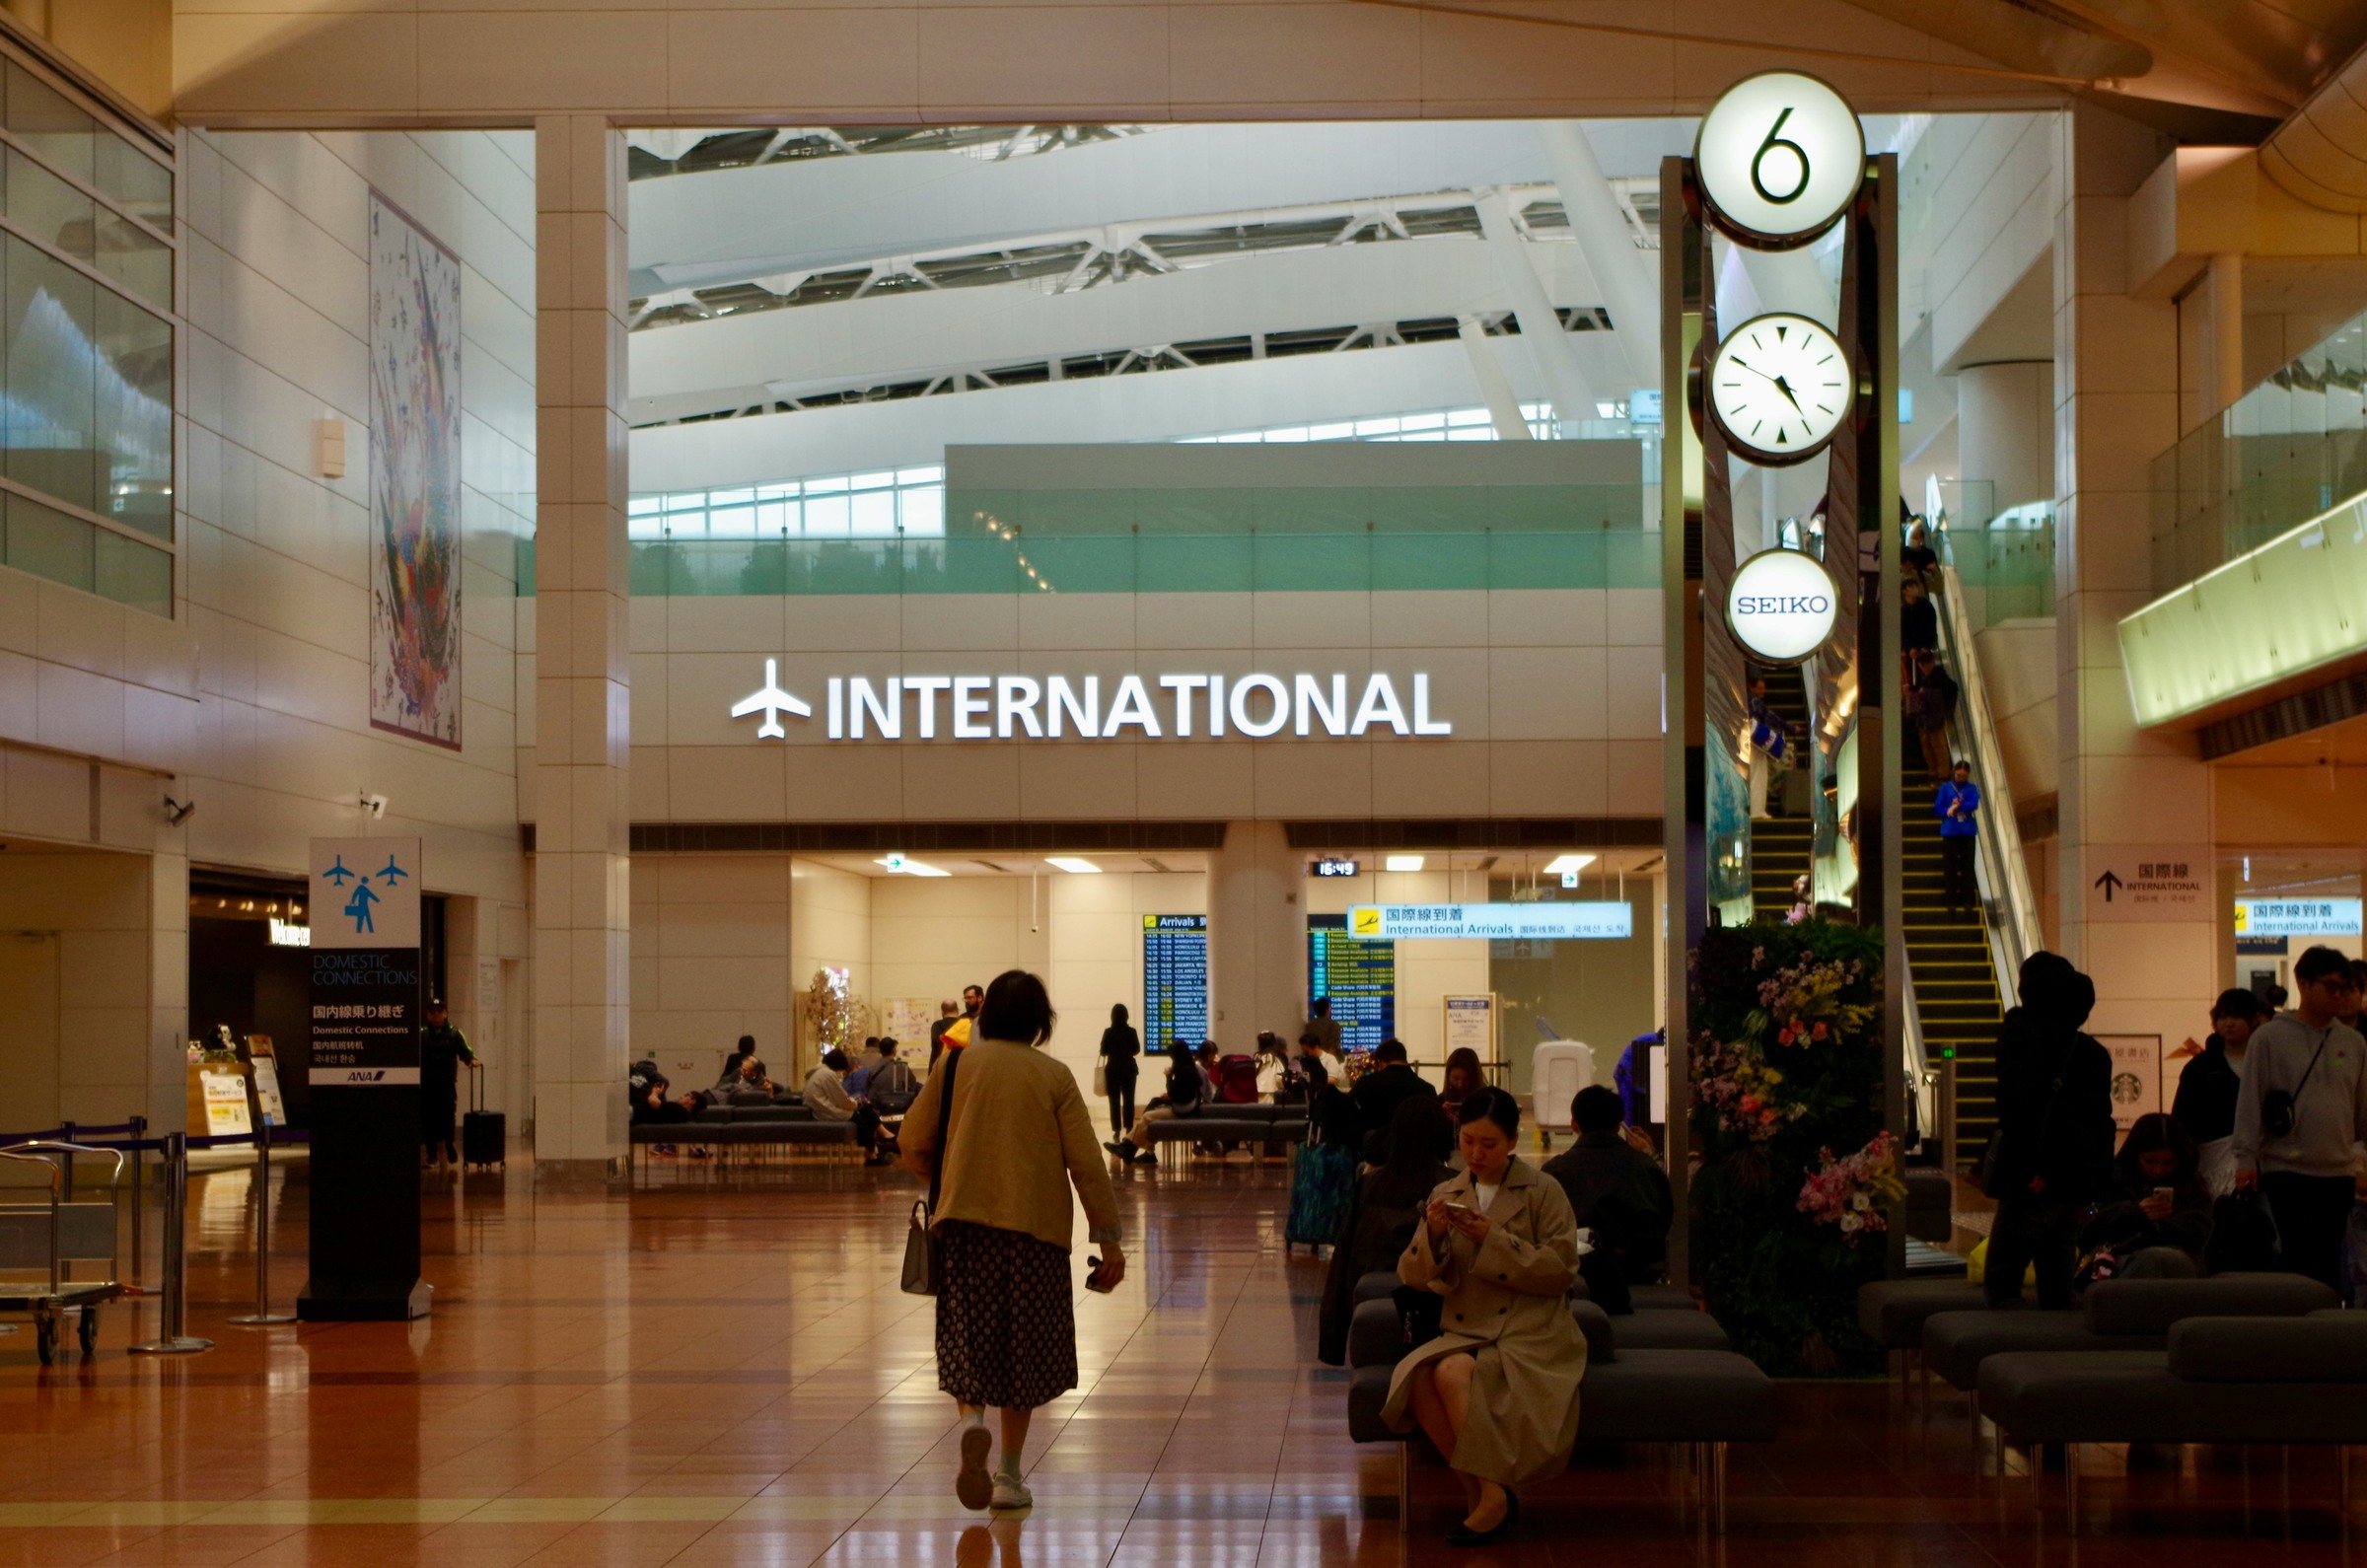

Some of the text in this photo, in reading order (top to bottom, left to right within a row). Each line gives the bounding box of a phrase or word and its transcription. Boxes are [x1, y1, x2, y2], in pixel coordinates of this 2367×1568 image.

[1751, 107, 1810, 205] 6
[1737, 595, 1829, 615] SEIKO
[827, 673, 1452, 740] INTERNATIONAL
[1320, 862, 1353, 876] 16:49
[2138, 863, 2188, 879] 国際線
[2126, 882, 2201, 891] INTERNATIONAL
[1386, 908, 1463, 922] 国際線到着
[2254, 904, 2331, 918] 国際線到着
[1160, 916, 1194, 927] Arrivals
[2254, 919, 2359, 932] International Arrivals
[1386, 923, 1513, 935] International Arrivals
[313, 954, 391, 969] DOMESTIC
[313, 970, 418, 986] CONNECTIONS
[313, 1004, 405, 1020] 国内線乗り継ぎ
[313, 1026, 409, 1034] Domestic Connections
[347, 1071, 373, 1082] ANA
